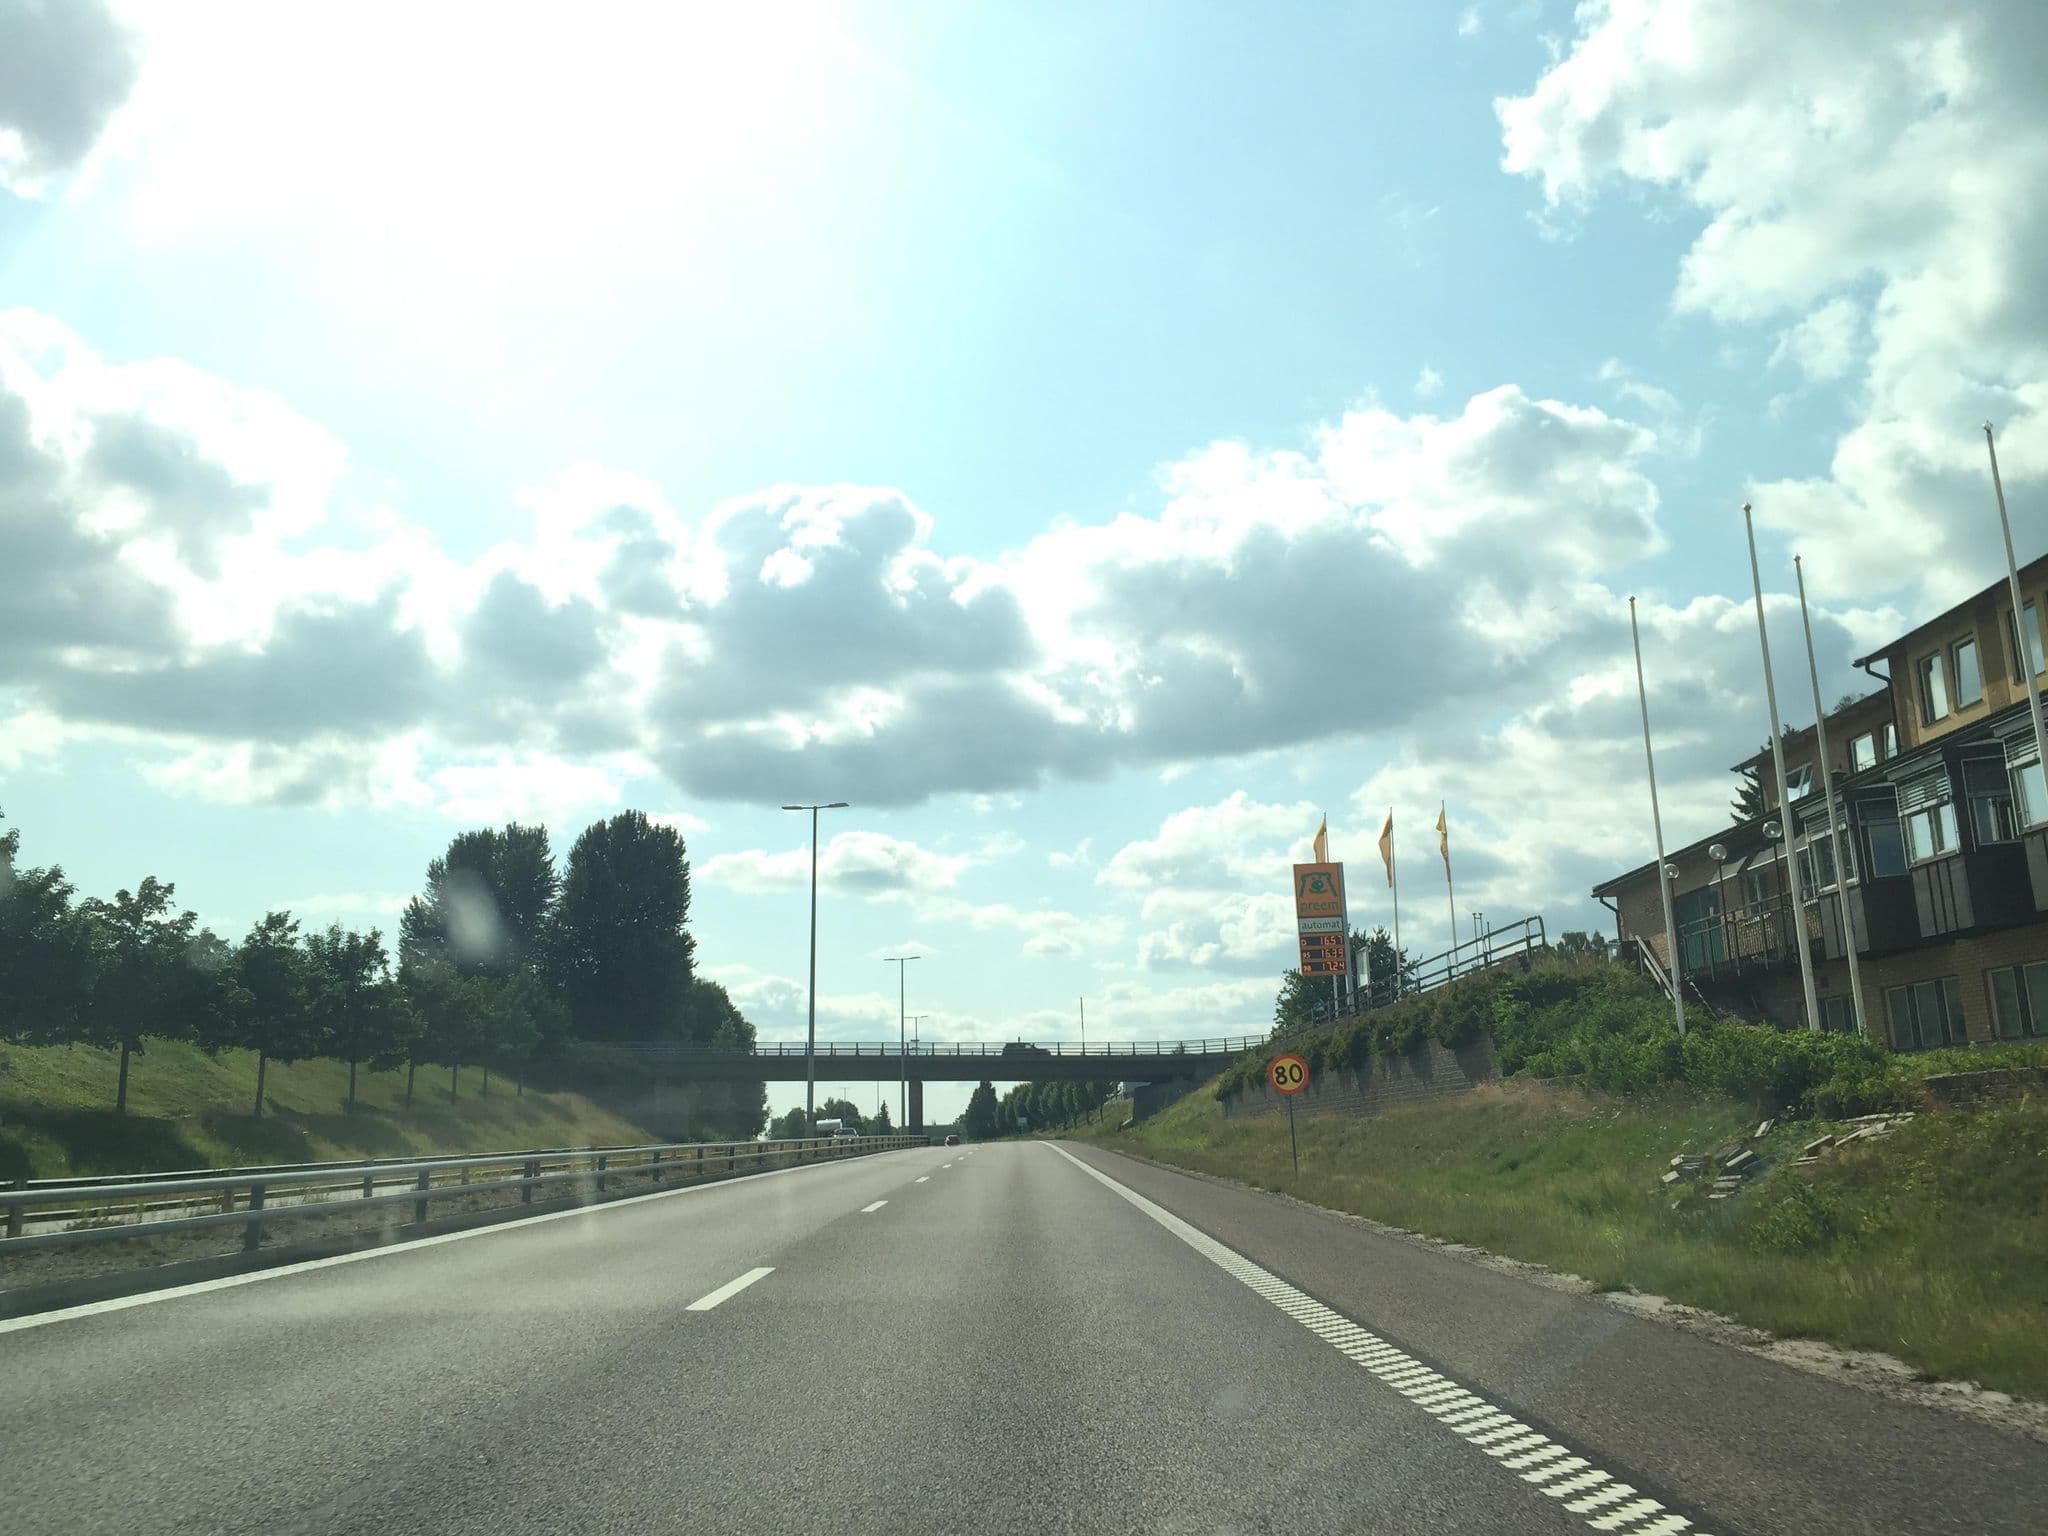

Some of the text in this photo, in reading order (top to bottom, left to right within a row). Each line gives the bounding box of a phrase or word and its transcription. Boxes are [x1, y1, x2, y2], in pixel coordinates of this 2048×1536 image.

[1300, 901, 1338, 912] preem
[1301, 920, 1340, 930] automat
[1275, 1063, 1303, 1085] 80
